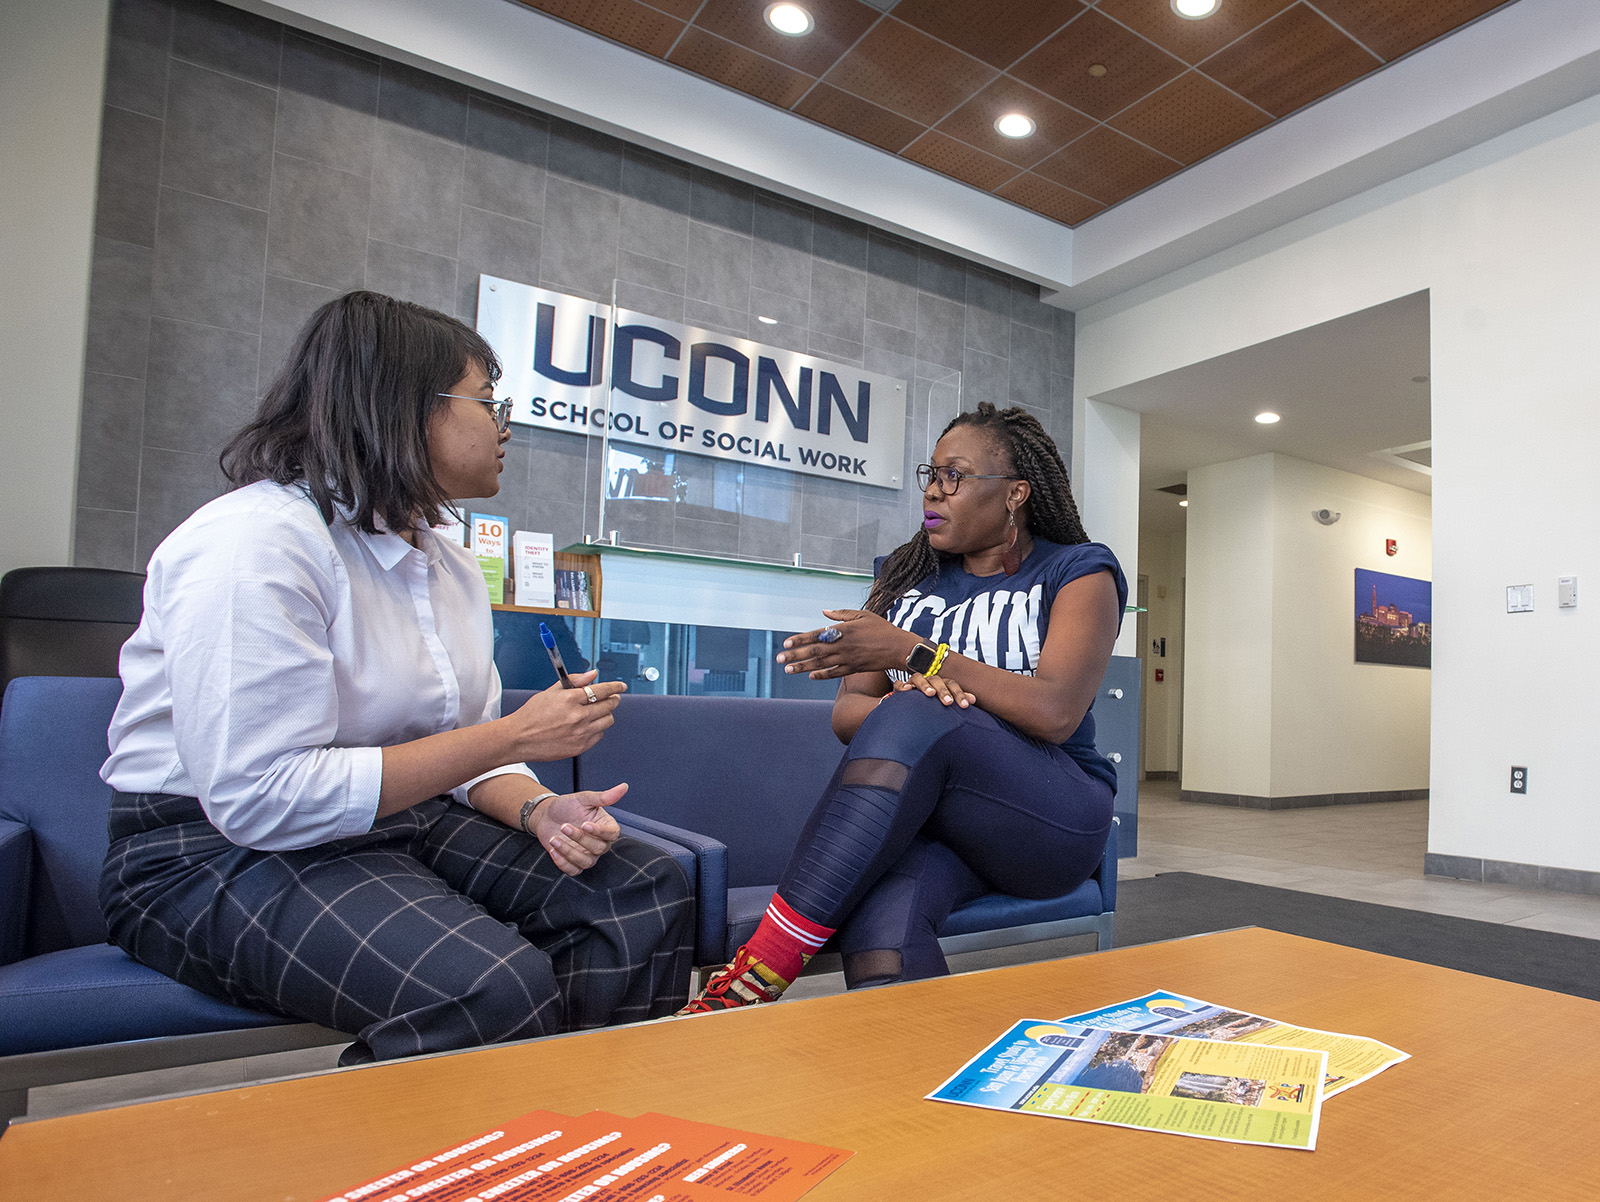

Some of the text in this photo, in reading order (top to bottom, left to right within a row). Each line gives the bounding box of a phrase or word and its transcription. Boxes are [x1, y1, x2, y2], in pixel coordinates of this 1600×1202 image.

[533, 301, 871, 443] UCONN
[531, 397, 867, 476] SCHOOL OF SOCIAL WORK
[478, 522, 502, 537] 10
[478, 537, 501, 547] Ways
[946, 1077, 975, 1099] UCONN
[980, 1057, 1006, 1074] Travel
[344, 1170, 415, 1199] SHELTER
[410, 1160, 438, 1172] OR
[432, 1131, 504, 1162] HOUSING?
[405, 1168, 474, 1197] SHELTER
[470, 1159, 497, 1171] OR
[492, 1130, 563, 1161] HOUSING?
[478, 1170, 543, 1199] SHELTER
[537, 1160, 563, 1172] OR
[556, 1131, 622, 1163] HOUSING?
[593, 1174, 619, 1187] OR
[610, 1142, 671, 1176] HOUSING?
